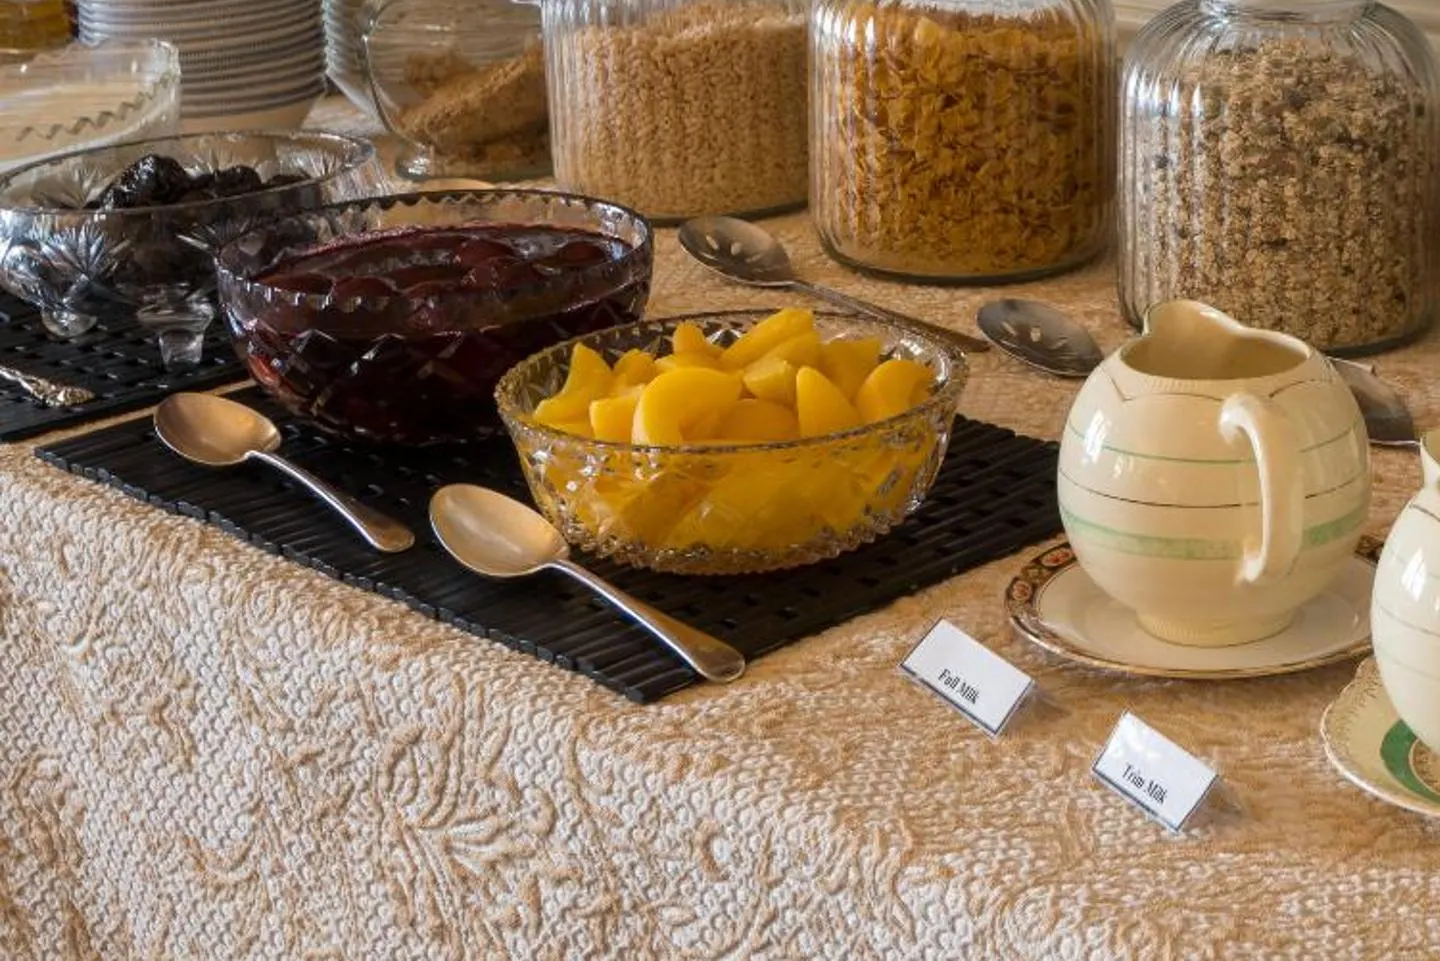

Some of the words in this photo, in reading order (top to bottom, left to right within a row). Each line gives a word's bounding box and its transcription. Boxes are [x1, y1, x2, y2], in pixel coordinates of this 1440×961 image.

[937, 668, 961, 690] Full
[956, 682, 980, 705] Milk
[1122, 761, 1145, 789] Trim
[1143, 779, 1168, 805] Milk
